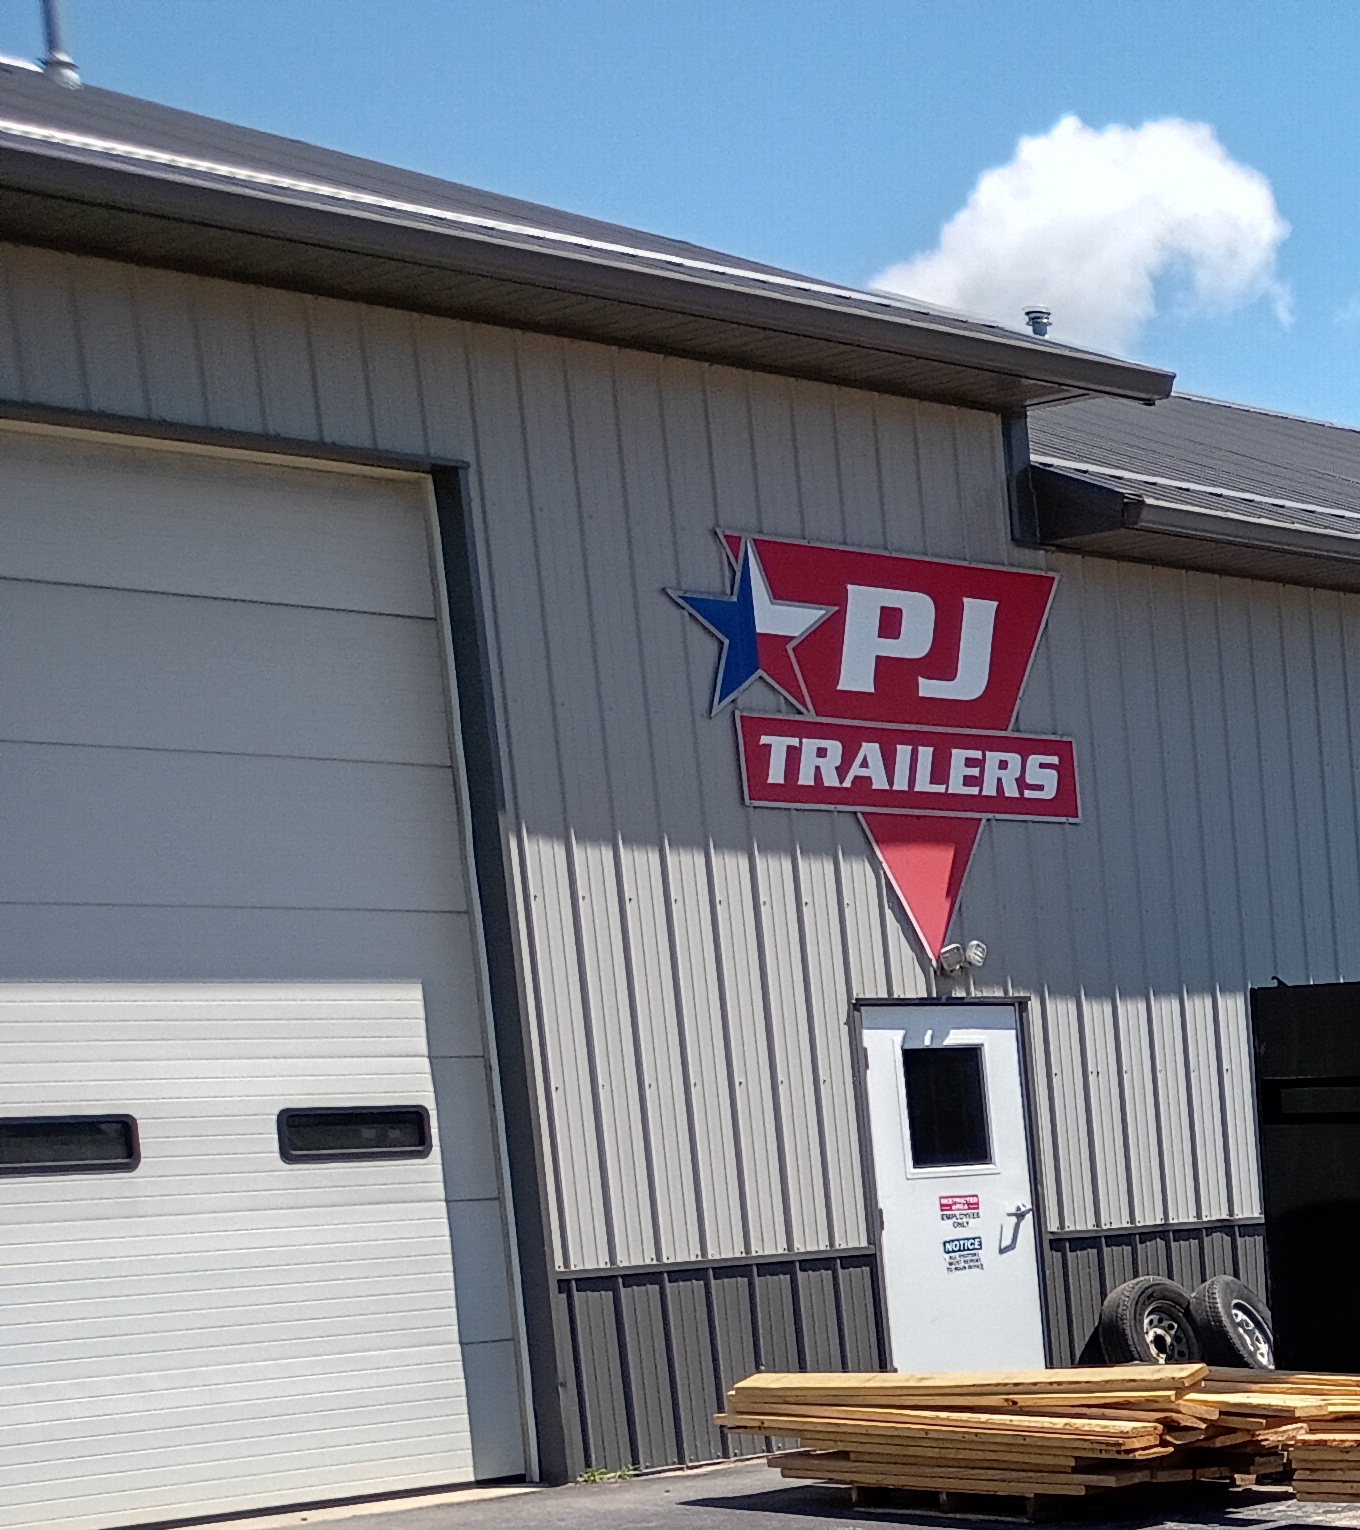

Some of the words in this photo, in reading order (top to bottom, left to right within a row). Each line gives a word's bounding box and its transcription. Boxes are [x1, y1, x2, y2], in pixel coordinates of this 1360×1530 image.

[836, 584, 998, 701] PJ
[759, 735, 1059, 800] TRAILERS
[952, 1220, 969, 1229] ONLY
[945, 1238, 981, 1252] NOTICE
